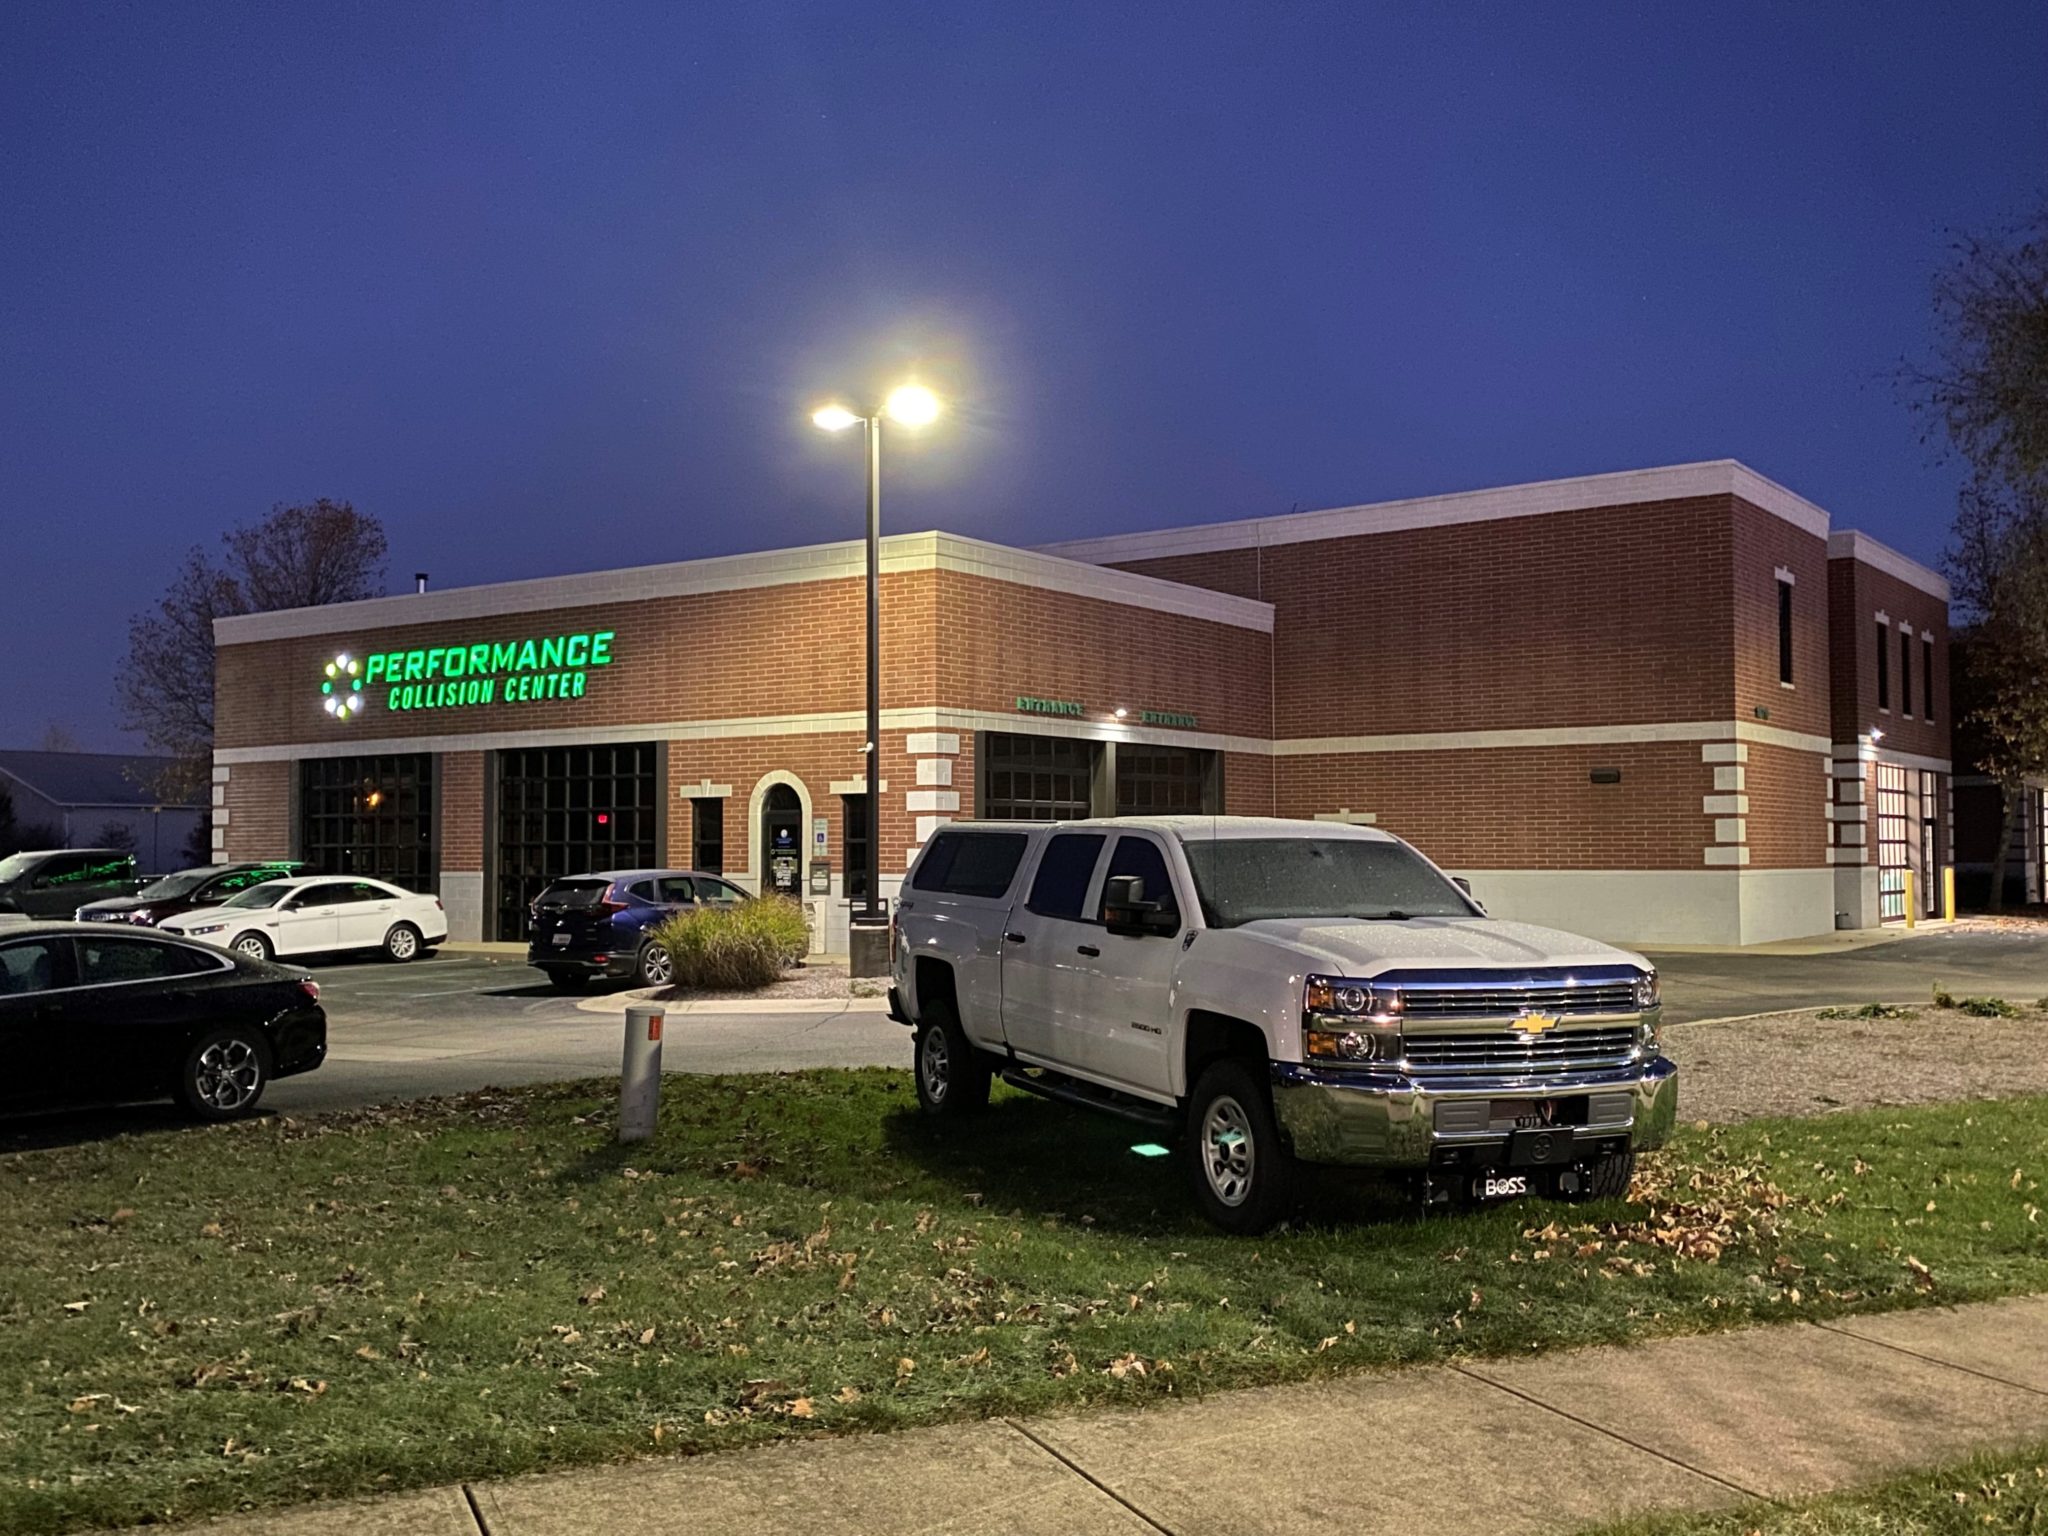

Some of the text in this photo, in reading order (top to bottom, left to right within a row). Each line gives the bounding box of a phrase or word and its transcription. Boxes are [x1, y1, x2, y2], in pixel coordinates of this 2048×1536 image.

[365, 631, 615, 684] PERFORMANCE
[388, 671, 587, 710] COLLISION CENTER
[1016, 696, 1084, 716] ENTRANCE
[1485, 1176, 1527, 1196] BOSS
